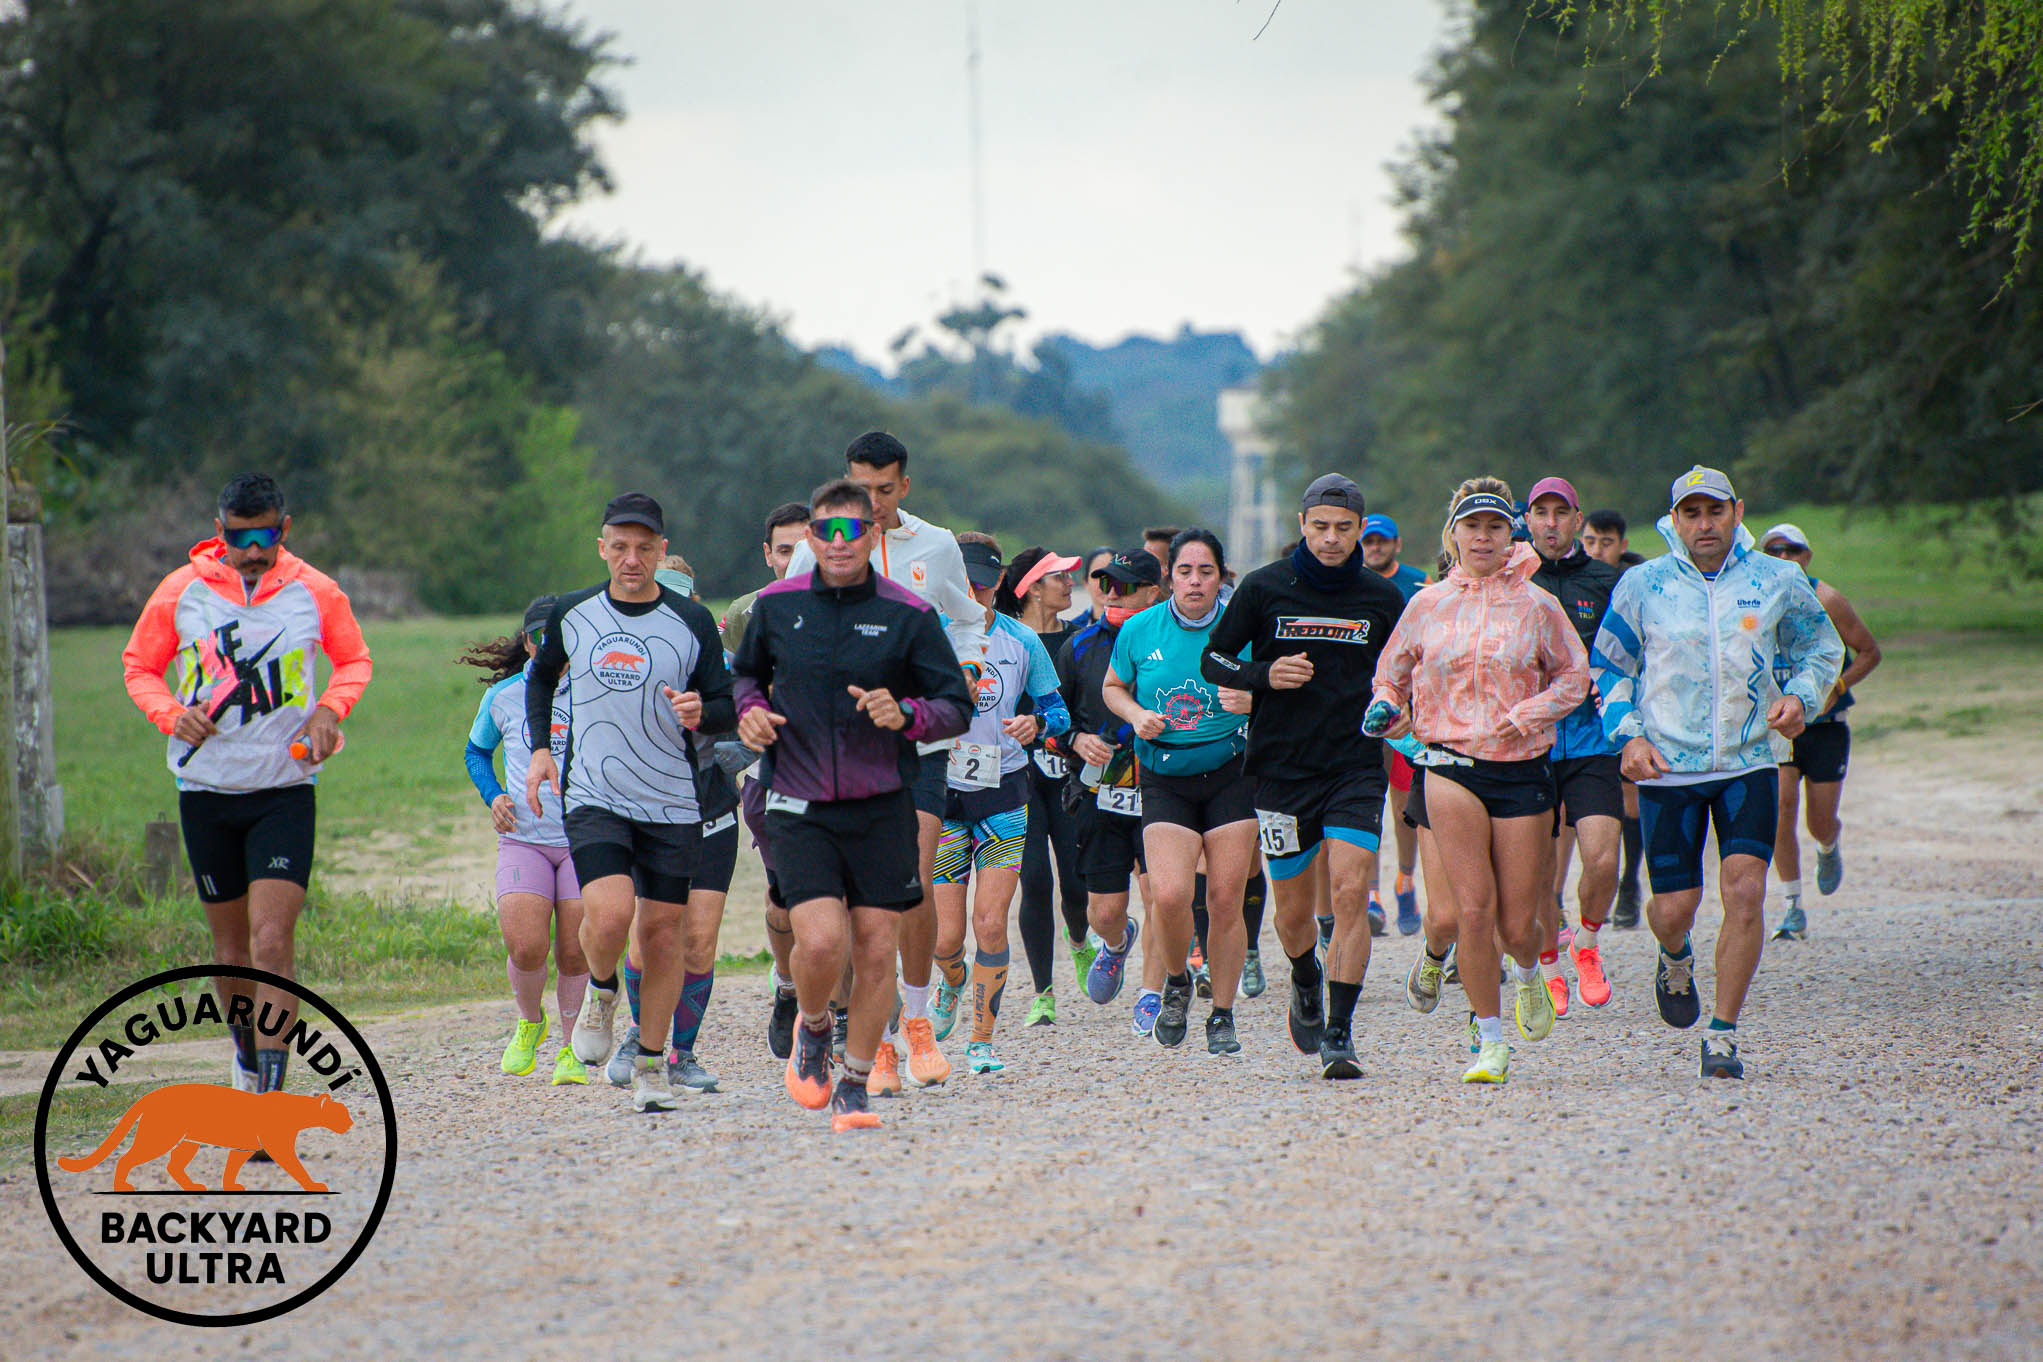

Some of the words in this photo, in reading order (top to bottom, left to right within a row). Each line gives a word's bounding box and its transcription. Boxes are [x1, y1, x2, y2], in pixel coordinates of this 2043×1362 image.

[599, 671, 641, 681] BACKYARD
[607, 679, 633, 687] ULTRA
[964, 758, 980, 781] 2
[1112, 792, 1137, 812] 21
[1262, 827, 1285, 852] 15
